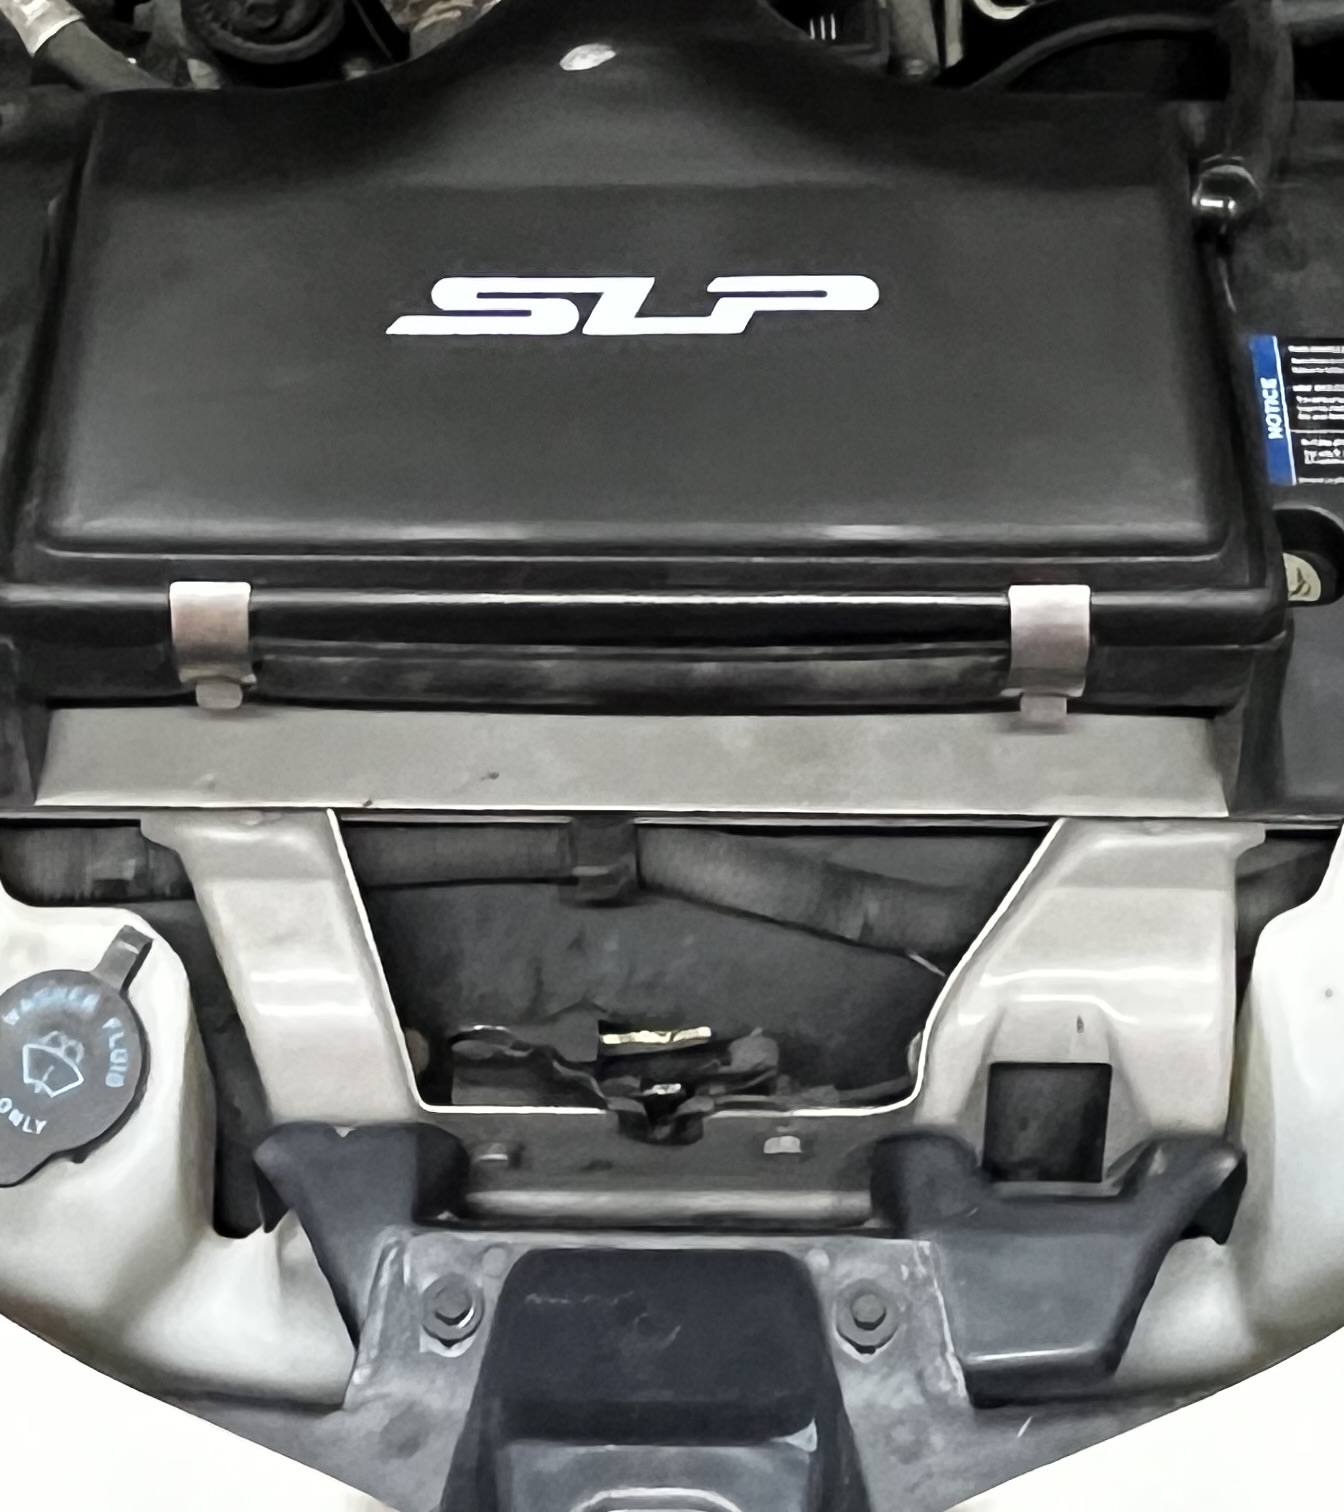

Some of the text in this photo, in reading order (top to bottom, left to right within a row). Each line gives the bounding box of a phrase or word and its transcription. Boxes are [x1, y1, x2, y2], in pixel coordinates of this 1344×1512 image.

[385, 275, 880, 336] SLP
[1260, 377, 1284, 440] NOTICE
[102, 1017, 128, 1088] FLUID
